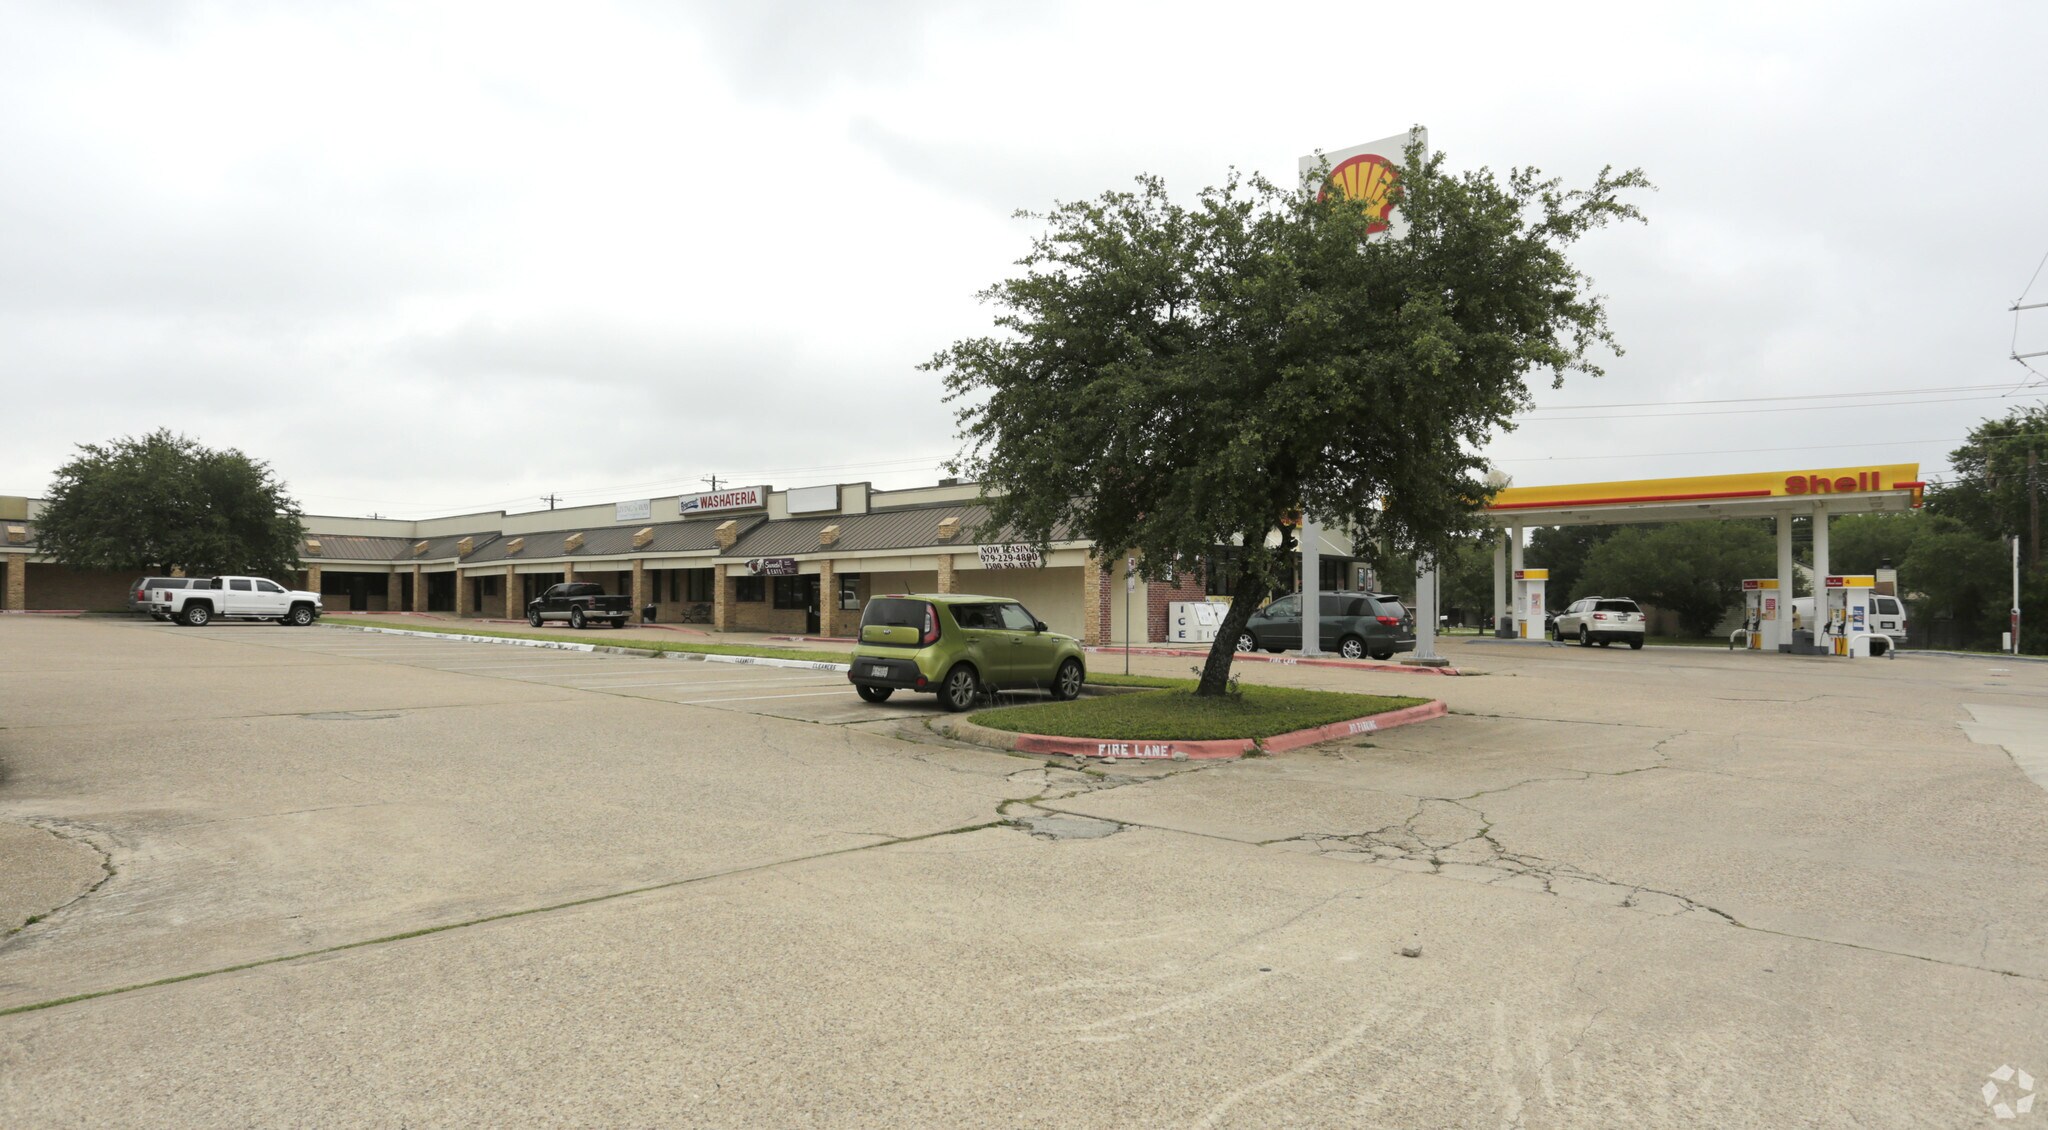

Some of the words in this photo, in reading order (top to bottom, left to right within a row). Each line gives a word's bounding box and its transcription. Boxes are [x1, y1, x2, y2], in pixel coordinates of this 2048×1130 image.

[1785, 471, 1880, 495] Shell
[700, 491, 757, 509] WASHATERIA
[981, 546, 1000, 554] NOW
[1178, 605, 1186, 638] ICE
[812, 662, 837, 670] CLEANERS
[1098, 743, 1129, 756] FIRE
[1135, 744, 1169, 757] LANE
